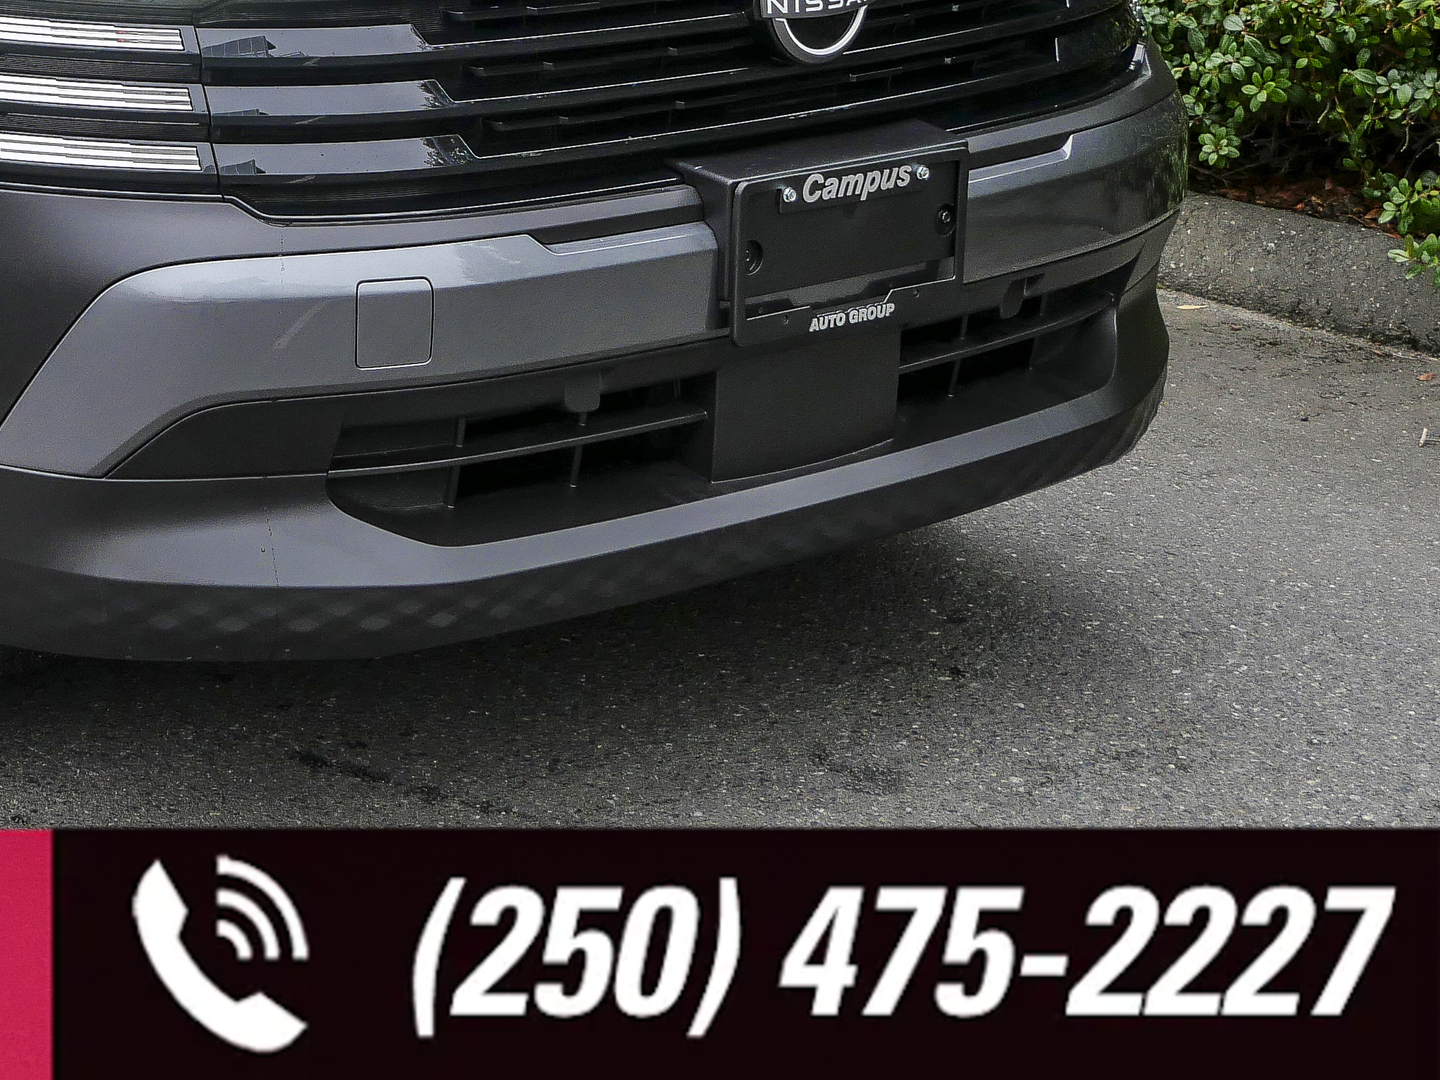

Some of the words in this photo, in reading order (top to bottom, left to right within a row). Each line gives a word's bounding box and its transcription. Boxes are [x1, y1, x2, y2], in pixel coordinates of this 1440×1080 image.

[802, 164, 913, 203] Campus
[808, 312, 846, 332] AUTO
[848, 303, 895, 324] GROUP
